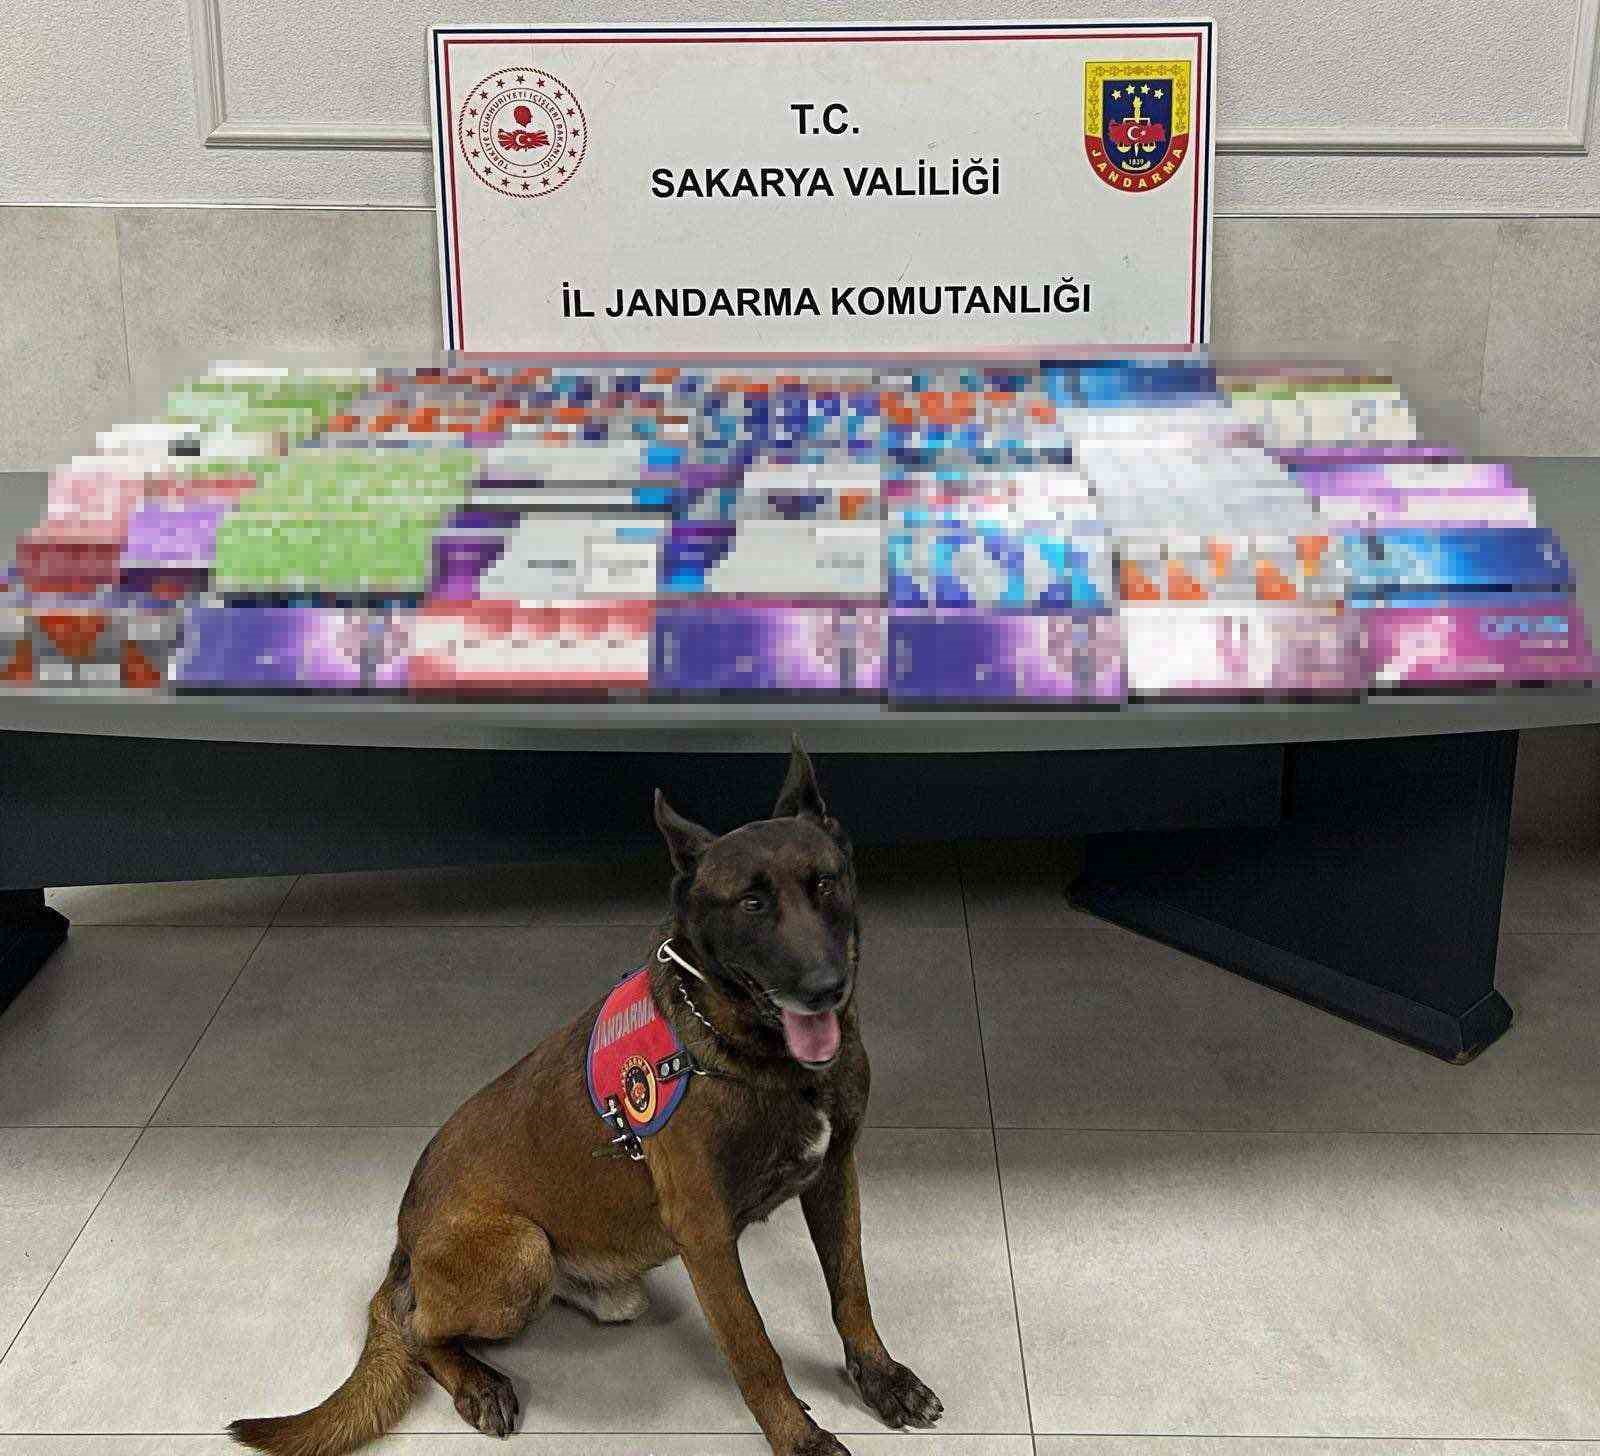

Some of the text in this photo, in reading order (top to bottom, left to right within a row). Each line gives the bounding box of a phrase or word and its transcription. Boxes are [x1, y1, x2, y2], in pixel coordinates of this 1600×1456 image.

[790, 103, 859, 135] T.C.
[651, 157, 1000, 198] SAKARYA VALİLİĞİ
[1091, 148, 1183, 188] JANDARMA
[562, 276, 1090, 318] İL JANDARMA KOMUTANLIĞI
